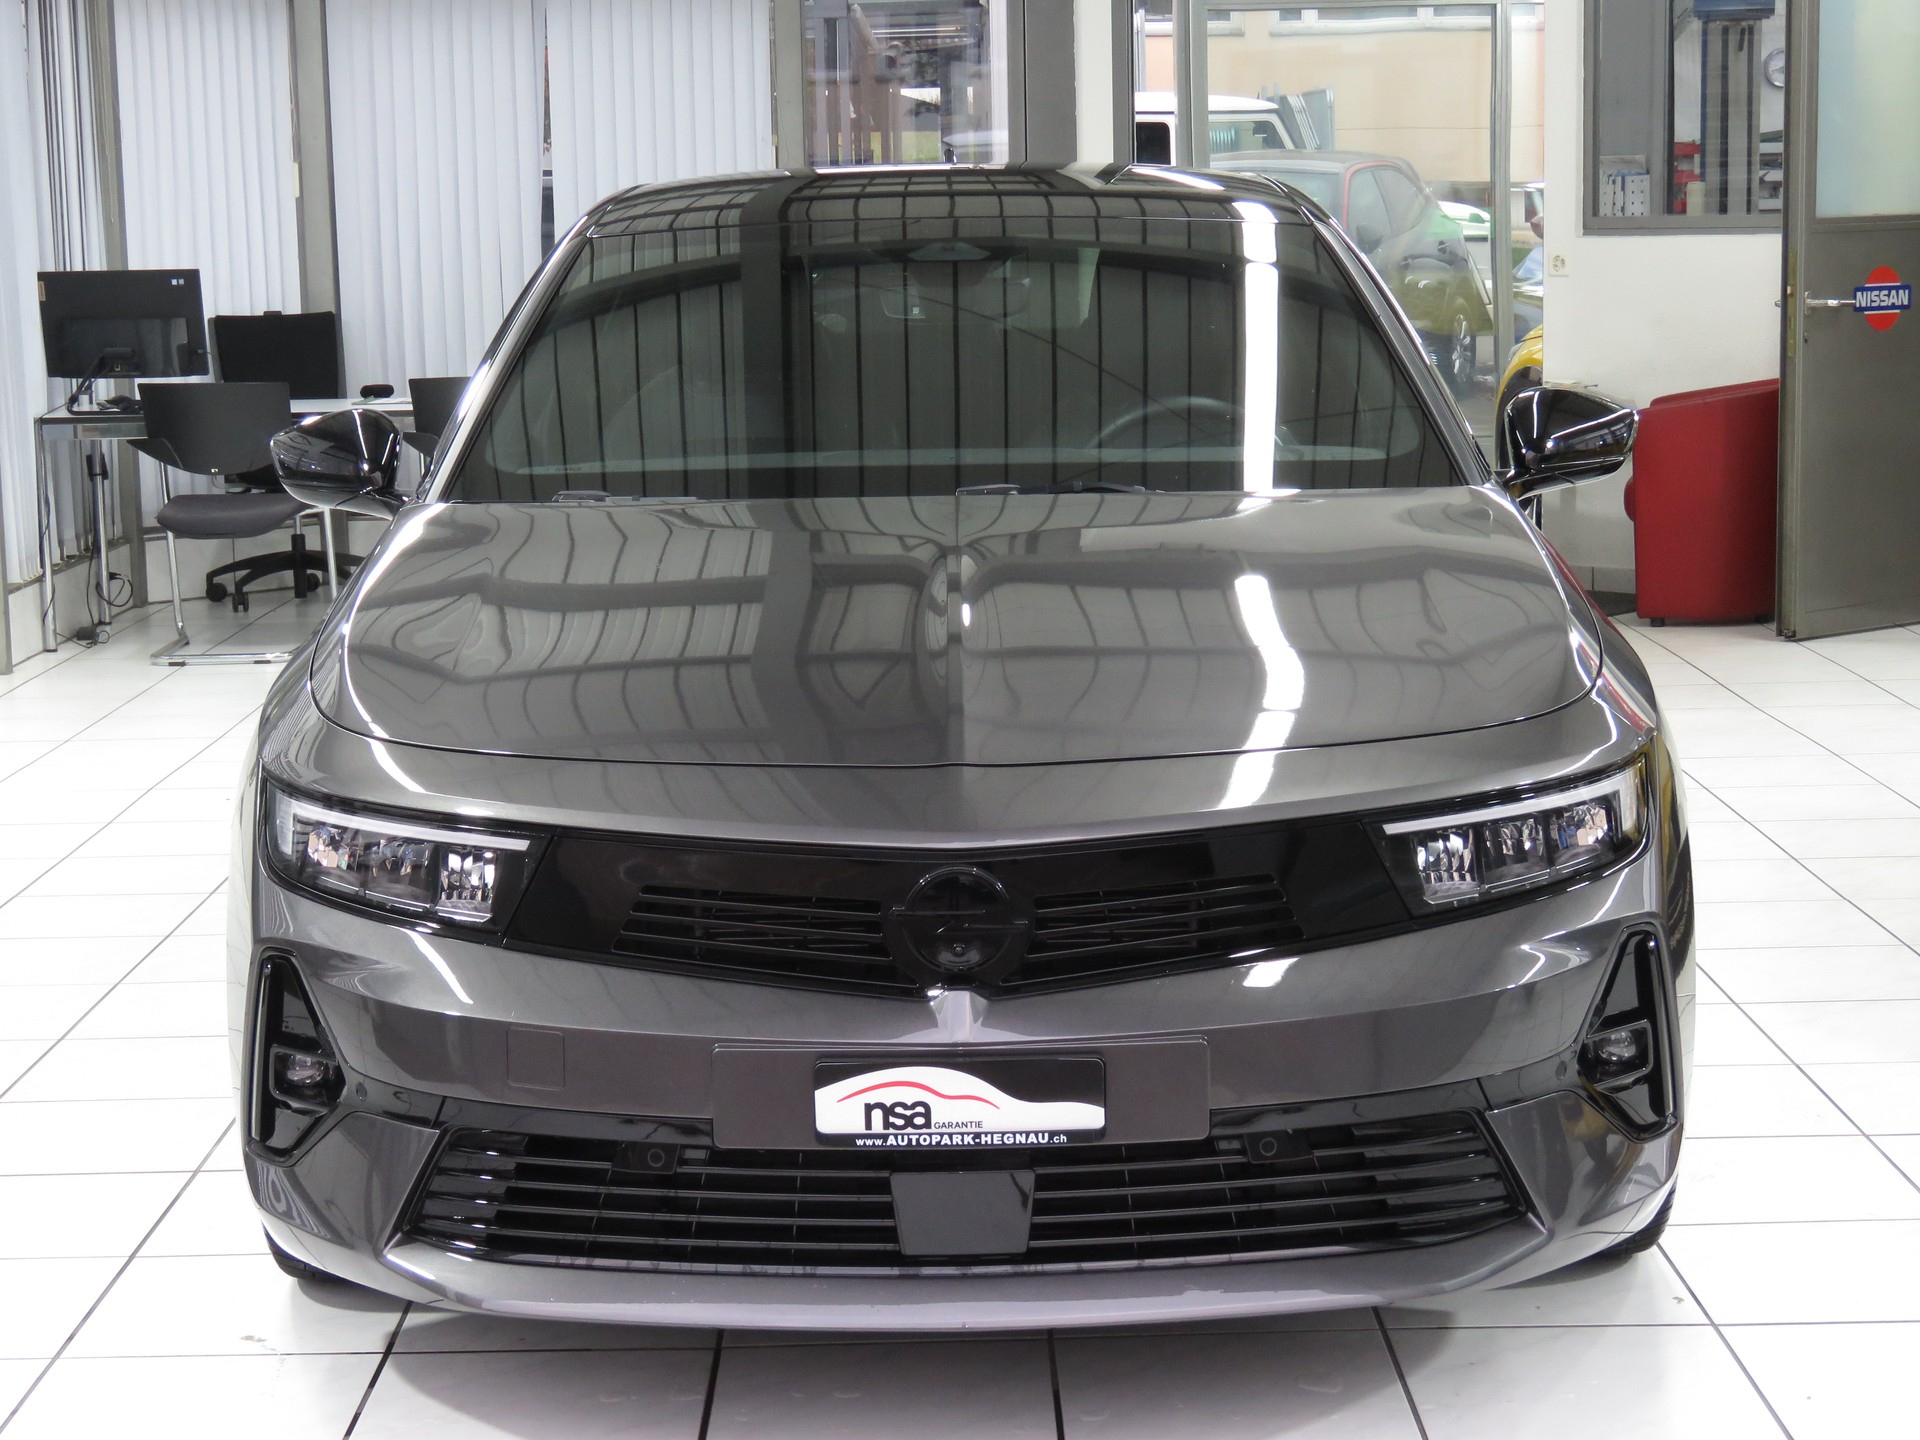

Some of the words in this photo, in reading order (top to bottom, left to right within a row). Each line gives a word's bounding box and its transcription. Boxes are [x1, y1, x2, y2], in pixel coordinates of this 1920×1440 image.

[1856, 290, 1909, 307] NISSAN
[864, 1100, 932, 1131] nsa
[934, 1120, 983, 1129] GARANTIE
[855, 1133, 1067, 1146] www.AUTOPARK-HEGNAU.ch
